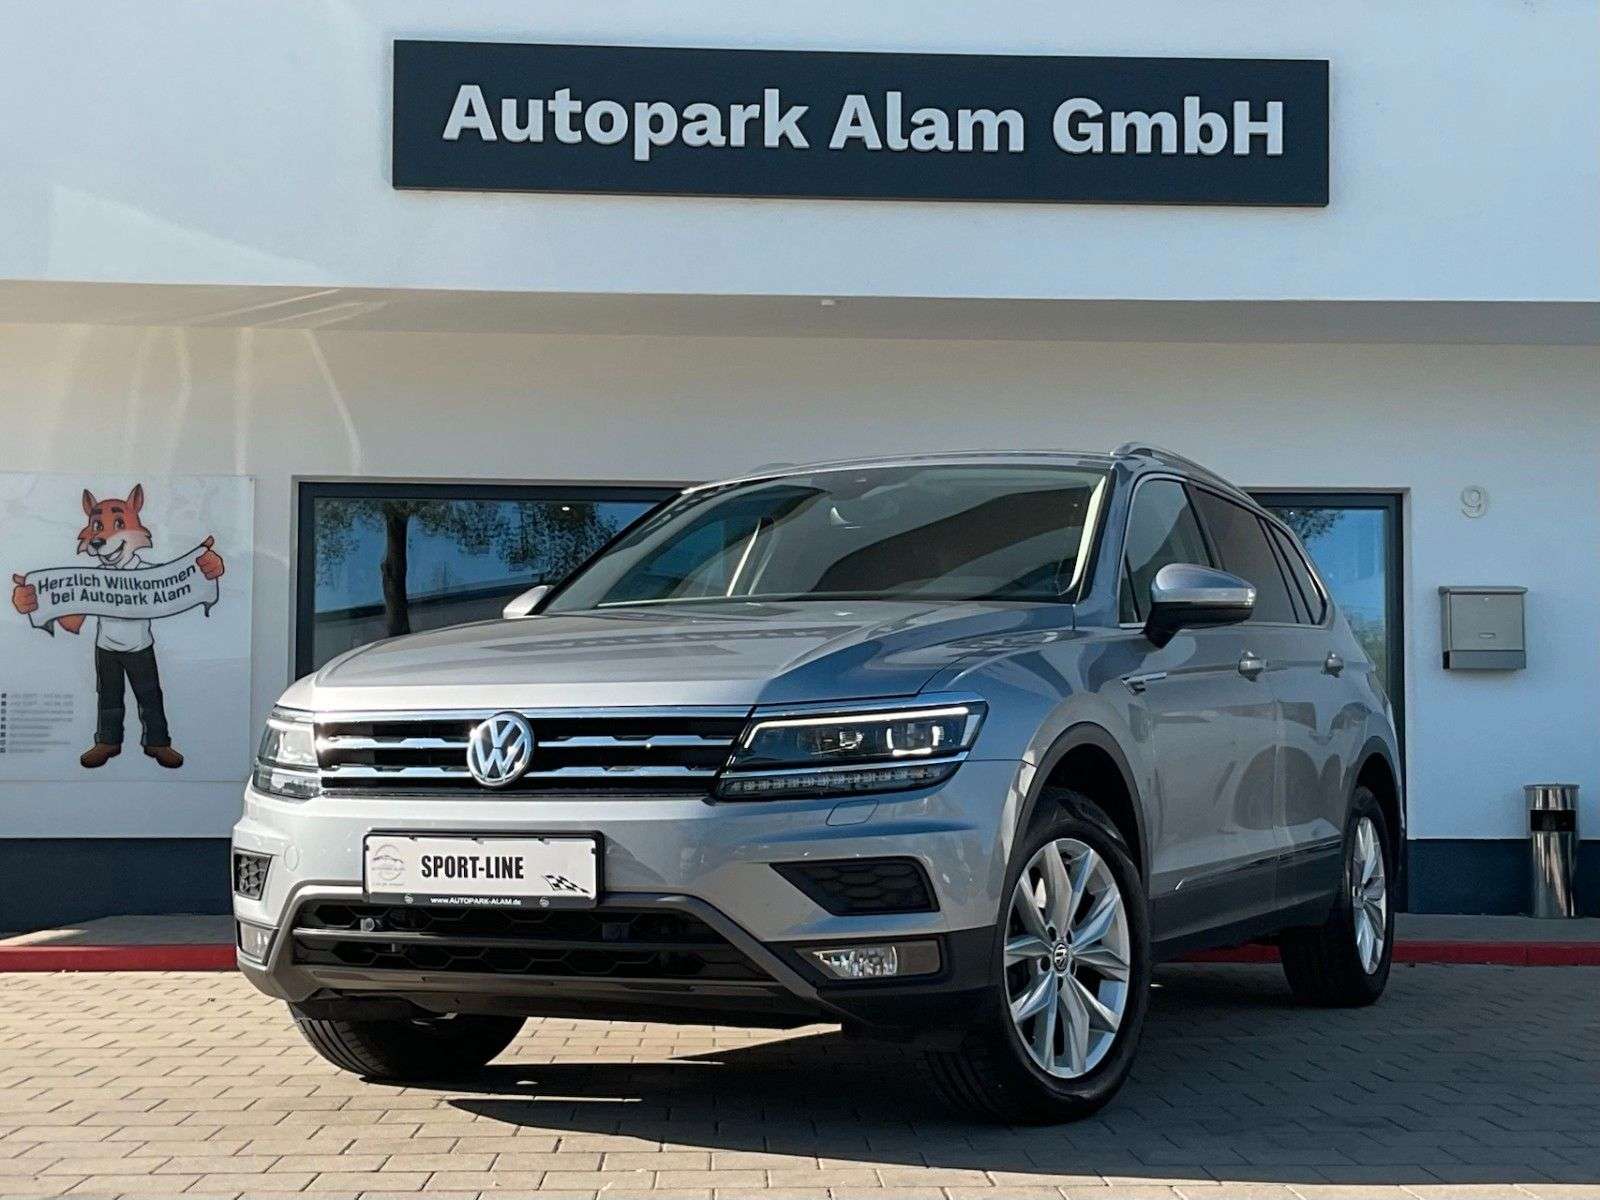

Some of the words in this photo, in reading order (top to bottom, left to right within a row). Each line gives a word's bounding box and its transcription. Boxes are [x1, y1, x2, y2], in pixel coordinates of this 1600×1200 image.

[442, 83, 810, 162] Autopark
[829, 90, 1025, 153] Alam
[1051, 96, 1285, 156] GmbH
[1461, 485, 1488, 518] 9
[38, 574, 100, 595] Herzlich
[104, 564, 197, 591] Willkommen
[51, 590, 75, 605] bei
[80, 588, 147, 606] Autopark
[153, 583, 191, 604] Alam
[468, 713, 531, 785] VW
[421, 855, 524, 880] SPORT-LINE
[430, 897, 521, 906] www.AUTOPARK-ALAM.de
